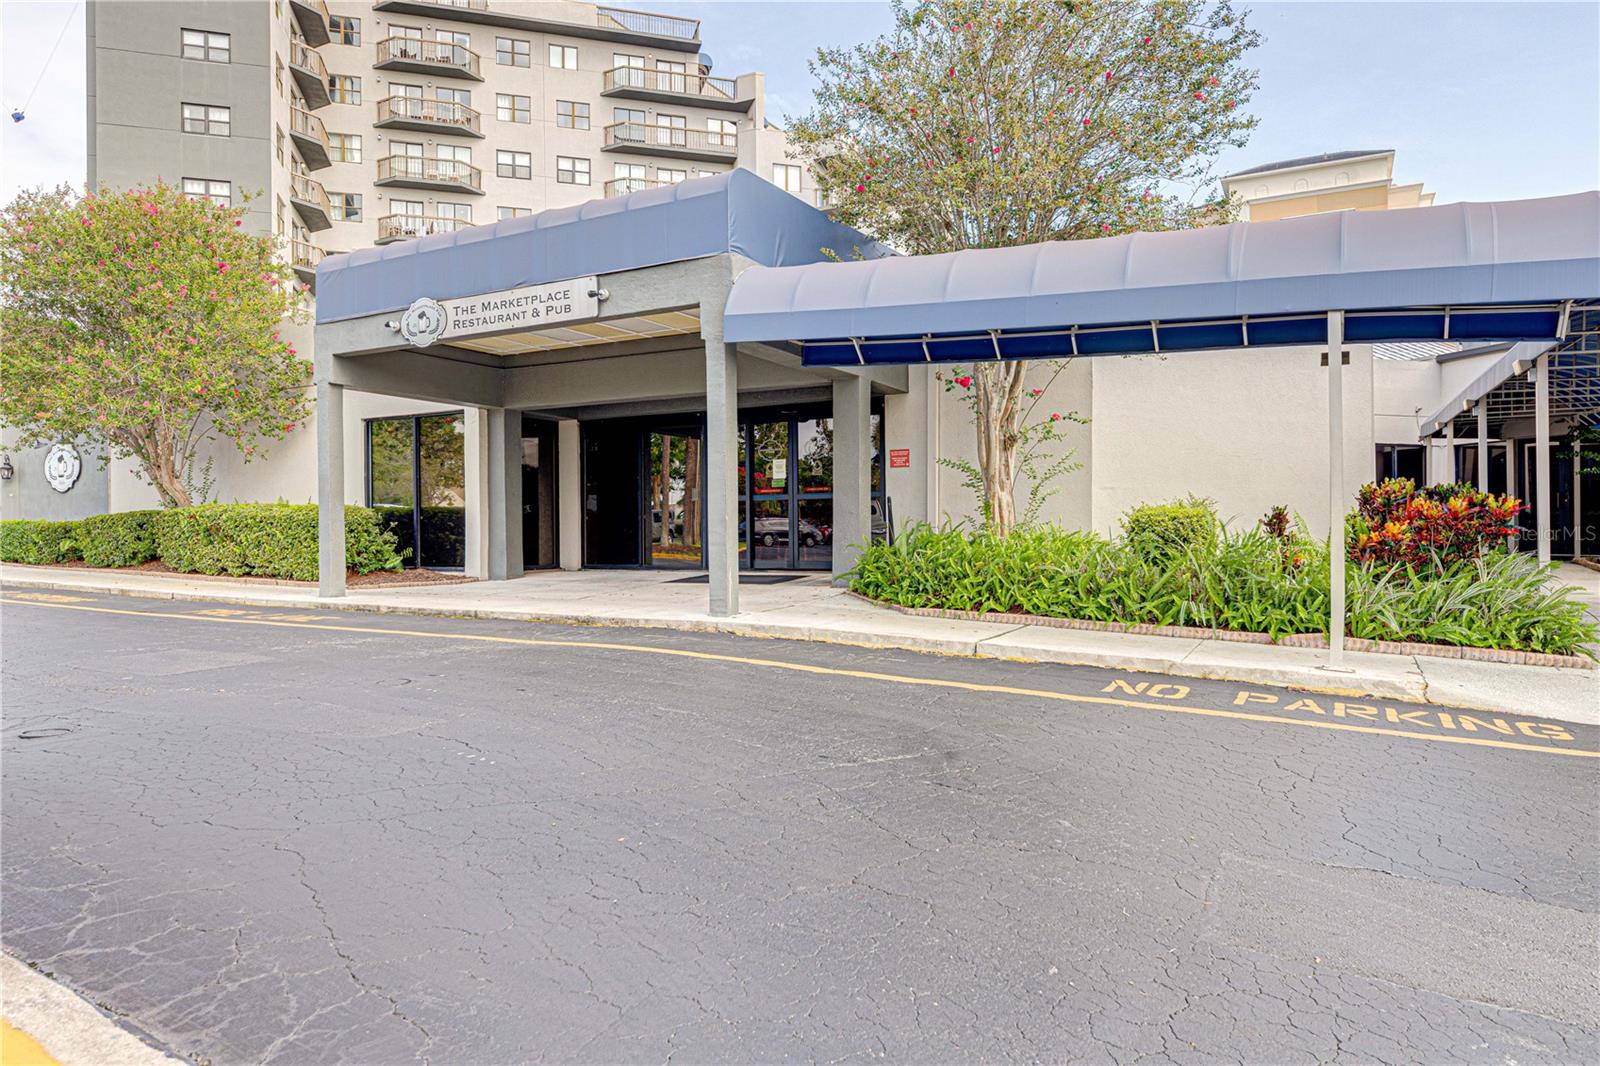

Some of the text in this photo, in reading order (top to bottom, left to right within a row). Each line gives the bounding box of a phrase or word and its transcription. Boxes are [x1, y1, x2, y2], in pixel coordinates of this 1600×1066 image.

[531, 307, 540, 318] &
[1099, 679, 1577, 742] NO PARKING
